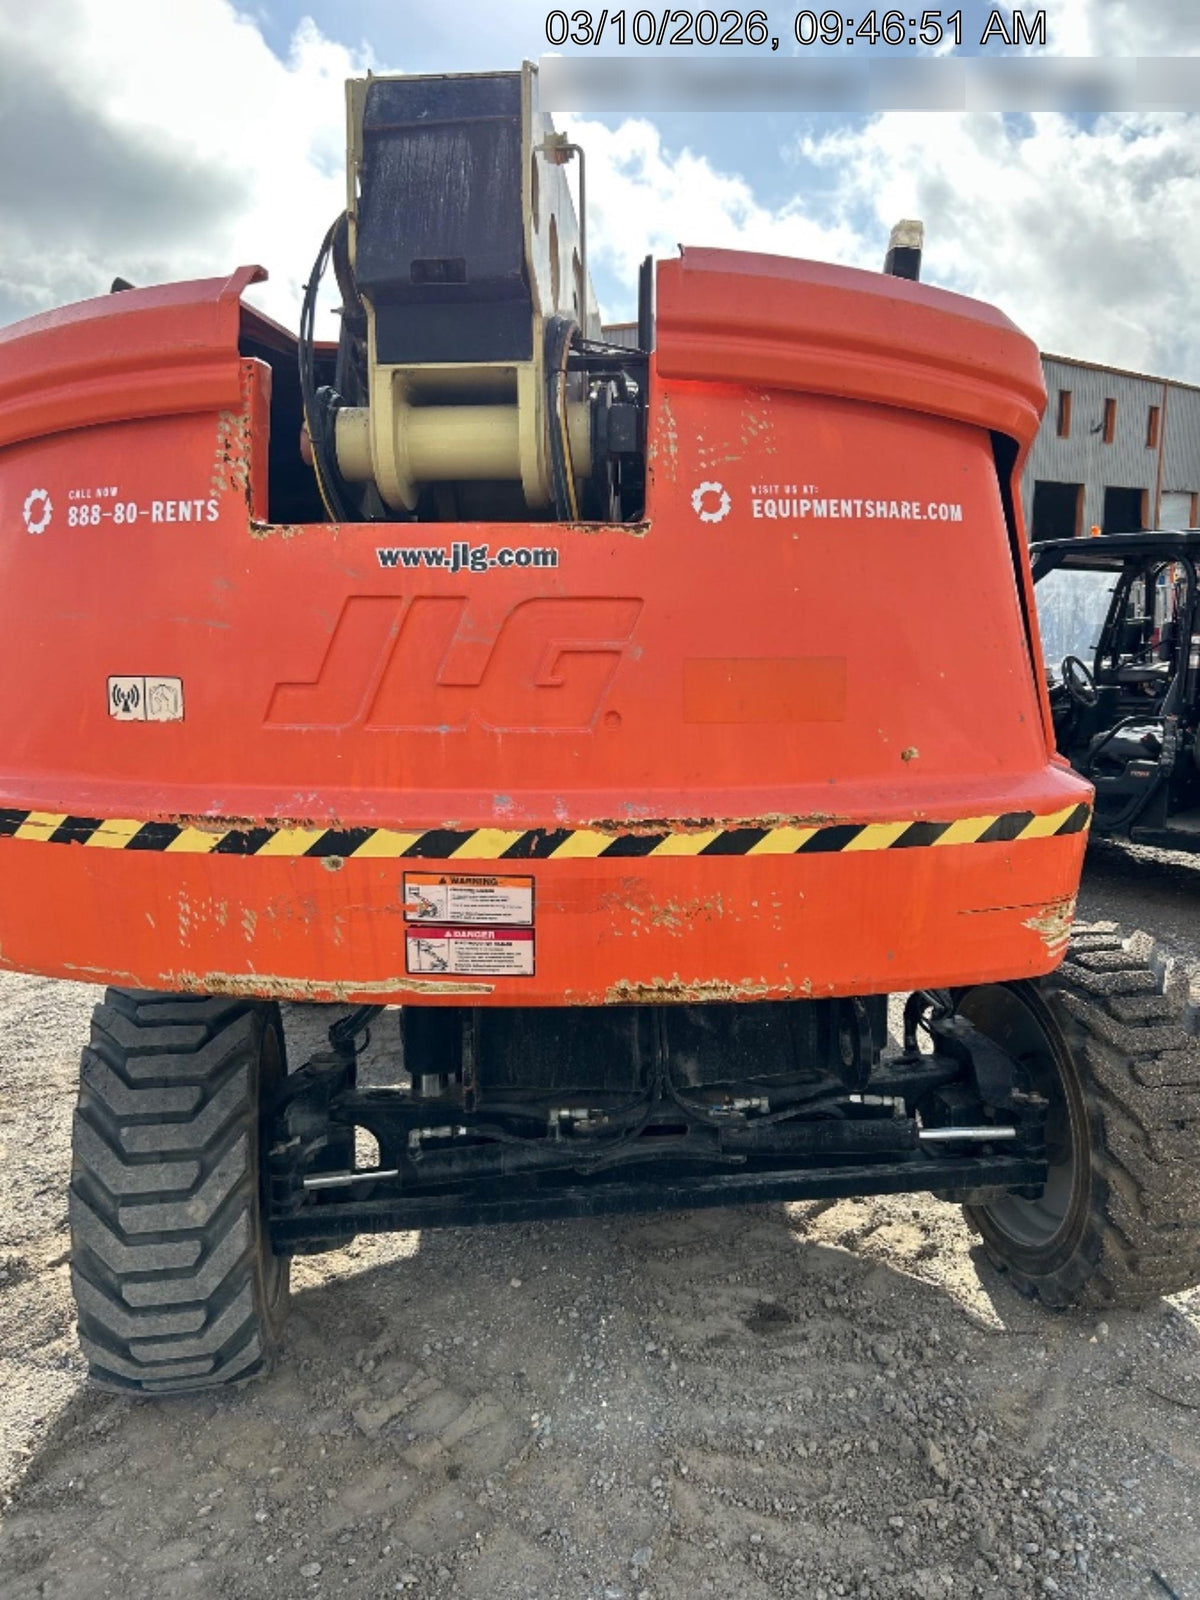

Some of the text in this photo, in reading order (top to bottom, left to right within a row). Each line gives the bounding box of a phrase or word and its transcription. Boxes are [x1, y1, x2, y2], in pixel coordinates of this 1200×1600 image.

[68, 487, 118, 500] CALL NOW
[750, 485, 819, 495] VISIT US AT:
[67, 499, 220, 527] 888-80-RENTS
[751, 498, 963, 522] EQUIPMENTSHARE.COM
[378, 542, 559, 573] www.jlg.com
[450, 877, 498, 886] WARNING
[453, 930, 495, 939] DANGER
